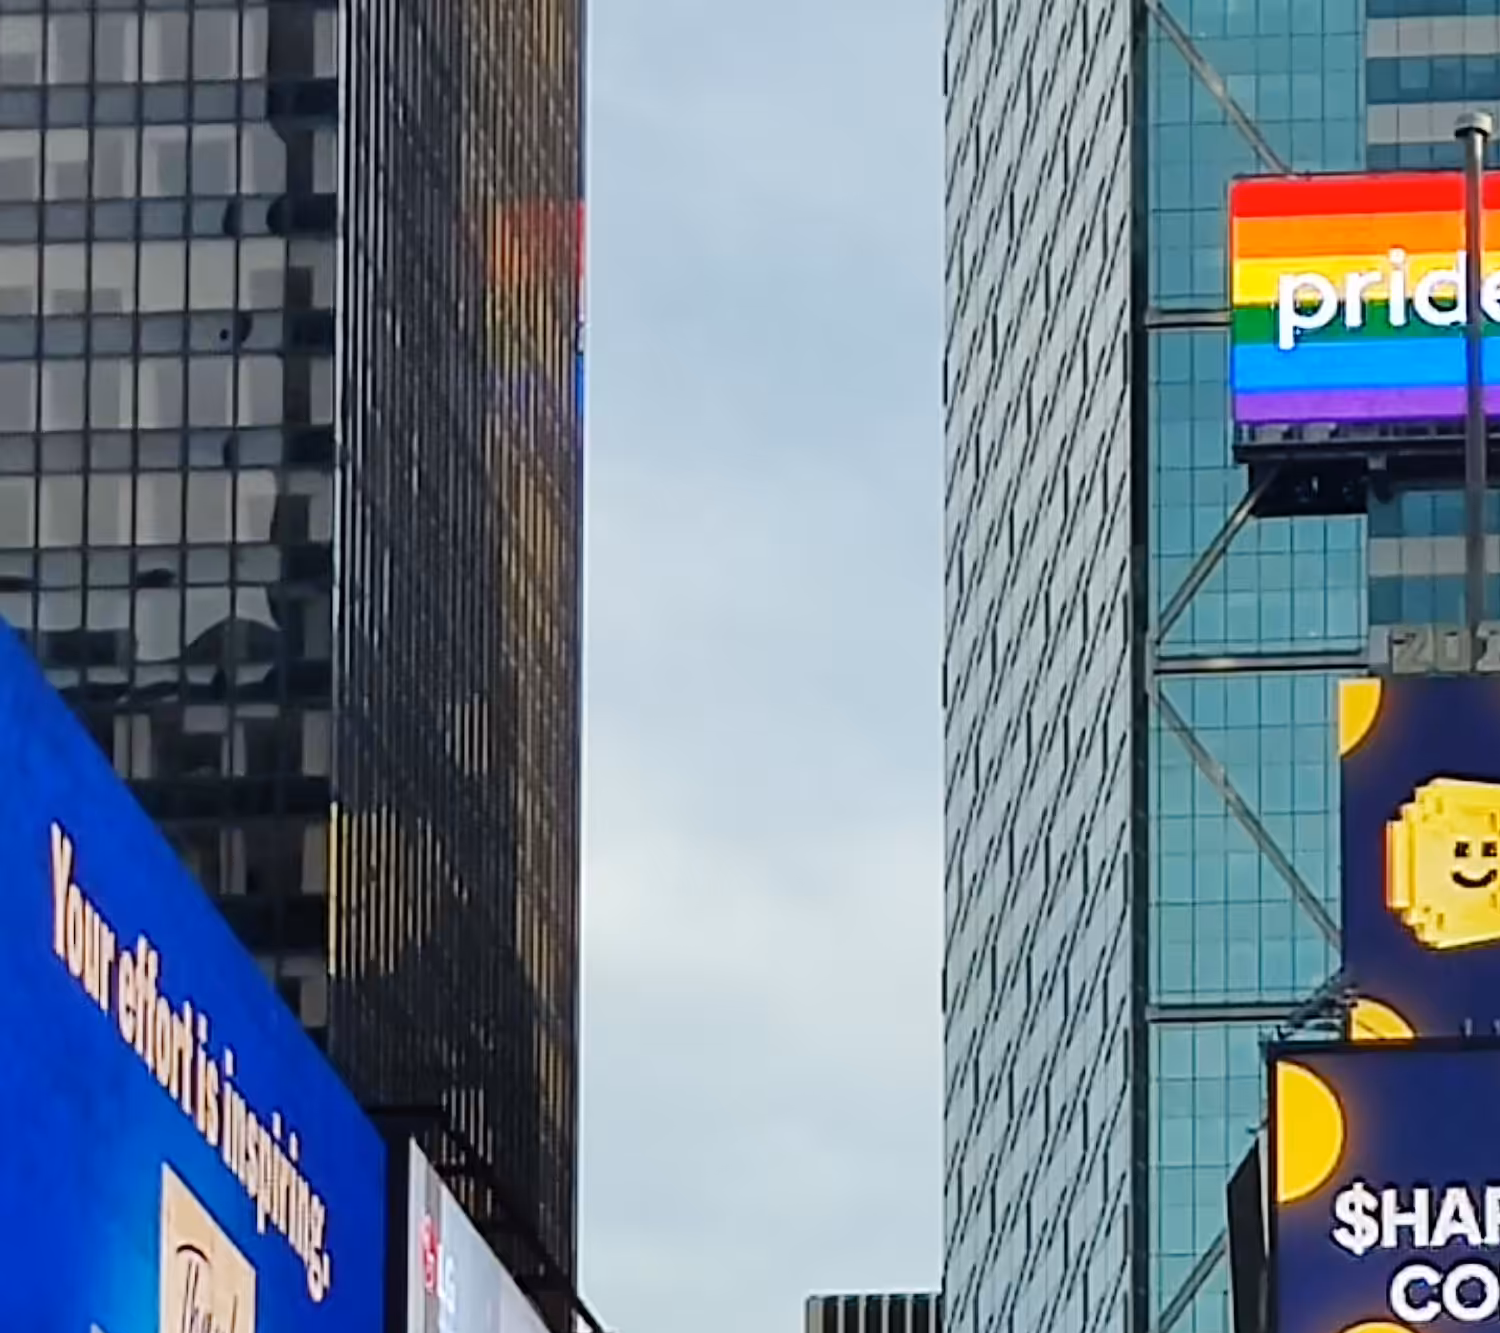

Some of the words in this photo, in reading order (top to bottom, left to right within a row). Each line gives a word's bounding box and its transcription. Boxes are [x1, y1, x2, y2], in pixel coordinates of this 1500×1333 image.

[49, 822, 119, 1012] Your
[115, 934, 194, 1118] effort
[196, 1012, 221, 1145] is
